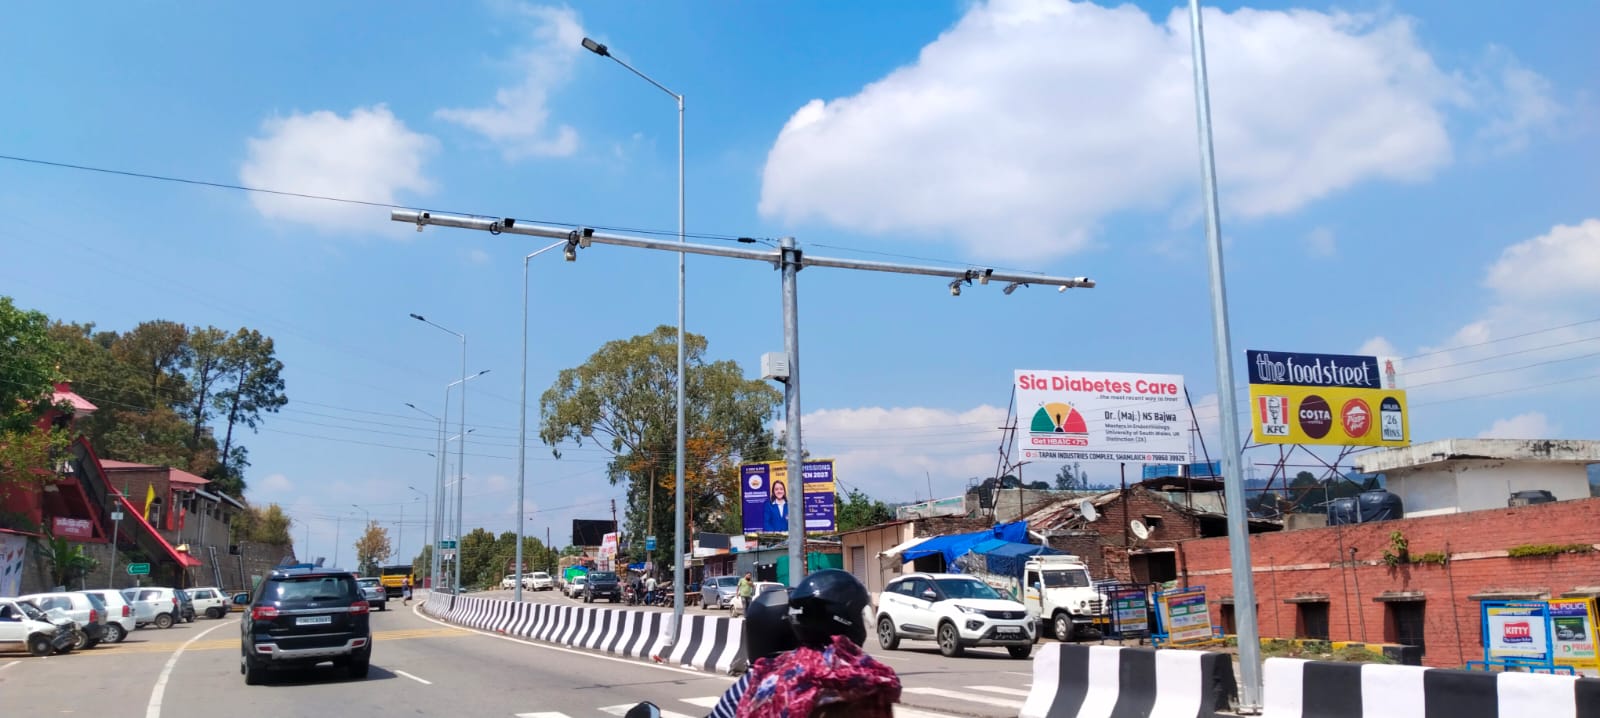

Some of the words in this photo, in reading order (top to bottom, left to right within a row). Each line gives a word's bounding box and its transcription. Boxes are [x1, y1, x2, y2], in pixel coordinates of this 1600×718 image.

[1256, 353, 1286, 382] the
[1019, 374, 1048, 390] Sia
[1052, 375, 1132, 394] Diabetes
[1135, 379, 1178, 395] Care
[1142, 412, 1153, 421] NS
[1154, 411, 1177, 423] Bajwa
[1300, 409, 1331, 421] COSTA
[1385, 415, 1398, 425] 26
[1266, 425, 1286, 435] KFC
[1505, 626, 1529, 635] KITTY
